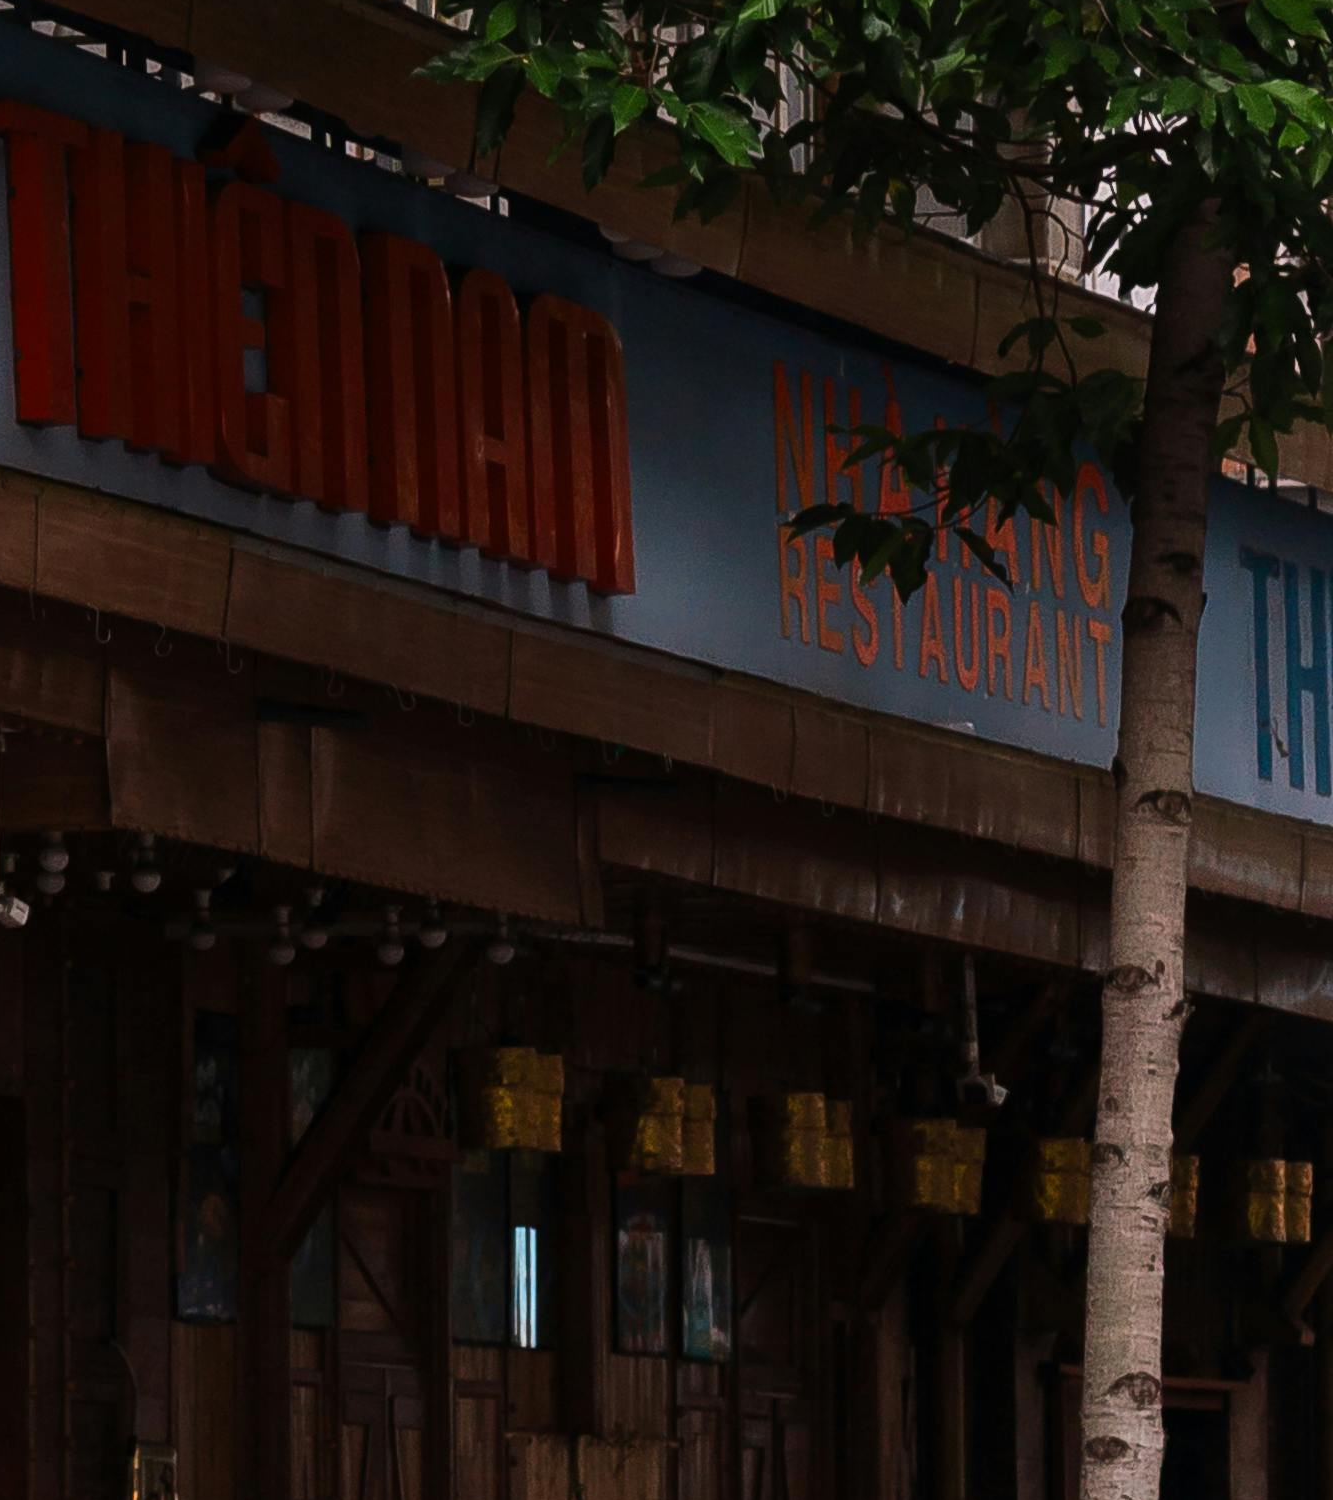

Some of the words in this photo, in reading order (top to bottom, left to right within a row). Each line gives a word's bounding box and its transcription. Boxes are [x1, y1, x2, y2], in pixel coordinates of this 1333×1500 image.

[359, 228, 636, 595] NAM
[777, 522, 1111, 728] RESTAURANT
[1240, 547, 1333, 797] TH
